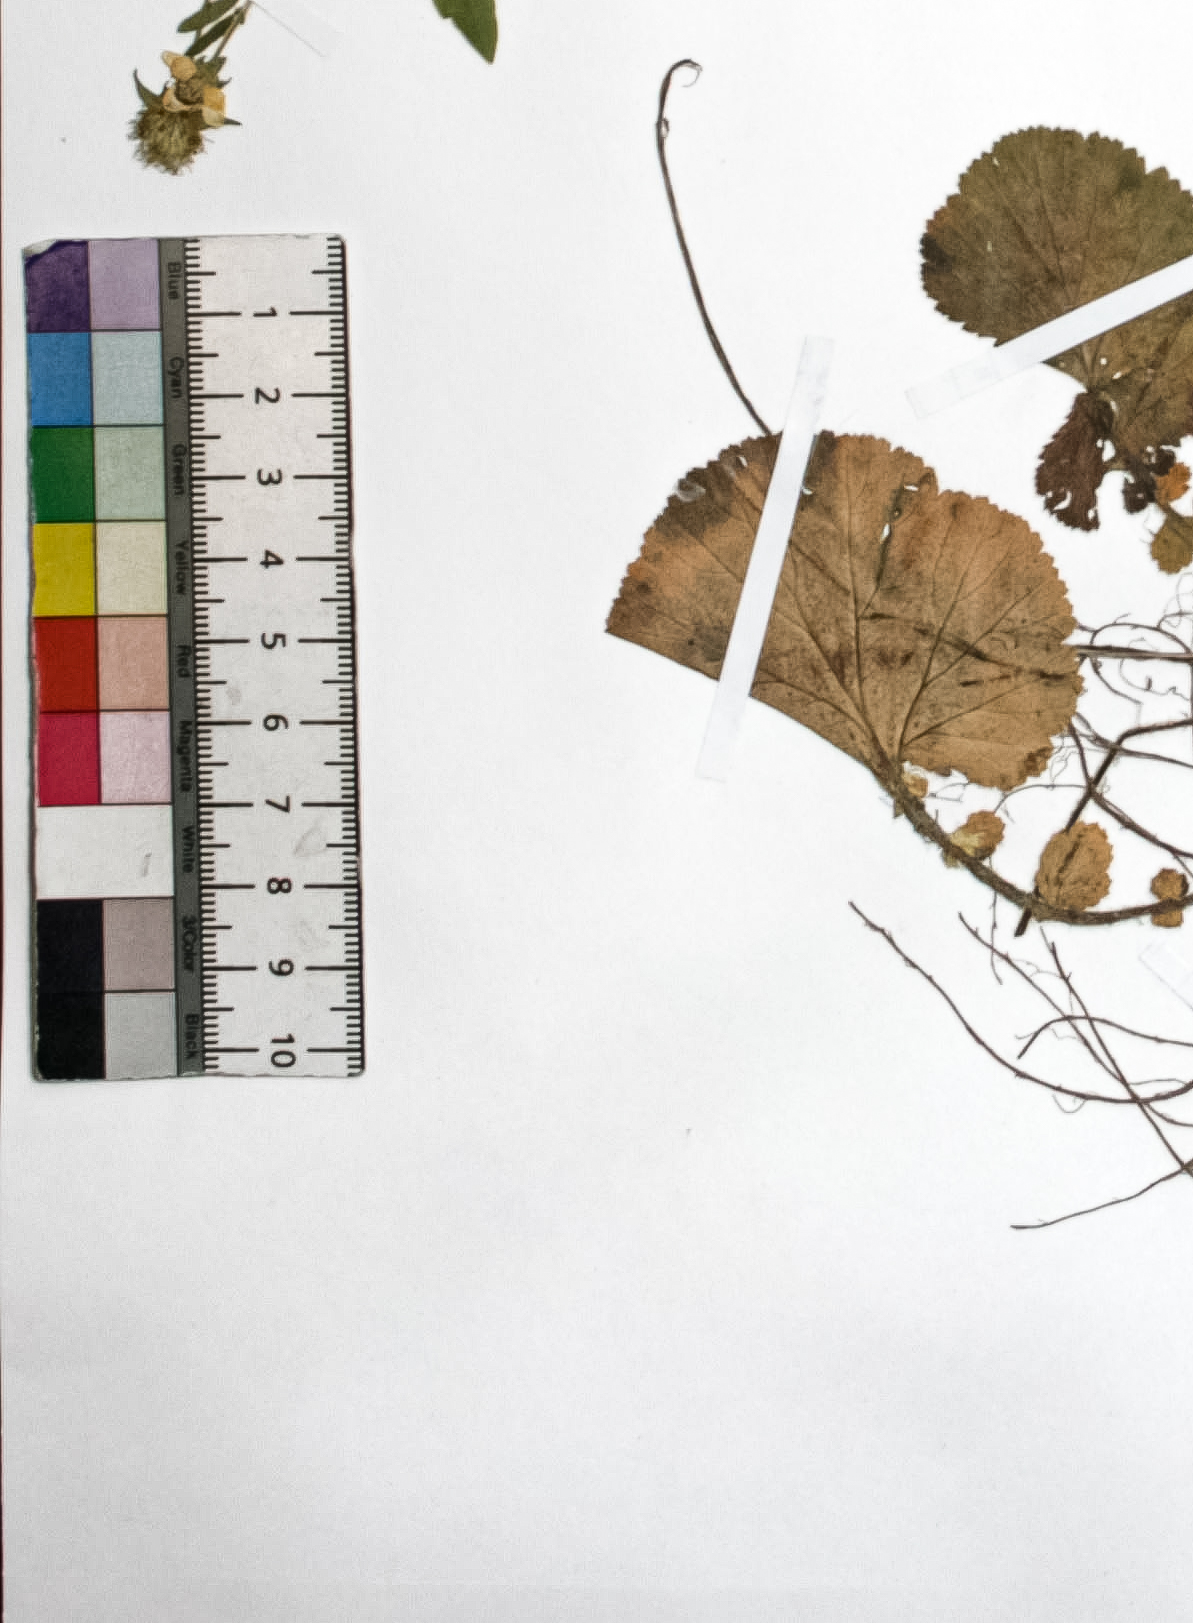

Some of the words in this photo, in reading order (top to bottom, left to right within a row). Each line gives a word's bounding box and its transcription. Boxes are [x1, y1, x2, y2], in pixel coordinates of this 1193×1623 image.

[167, 262, 182, 300] Blue
[252, 306, 277, 318] 1
[166, 357, 186, 399] Cyan
[254, 388, 281, 405] 2
[173, 444, 188, 495] Green
[257, 469, 283, 486] 3
[175, 539, 190, 595] Yellow
[259, 549, 284, 569] 4
[261, 632, 286, 649] 5
[177, 644, 191, 677] Red
[262, 714, 289, 732] 6
[265, 795, 290, 813] 7
[182, 825, 196, 873] White
[267, 877, 292, 894] 8
[269, 959, 295, 976] 9
[184, 1014, 200, 1058] Black
[270, 1034, 296, 1068] 10
